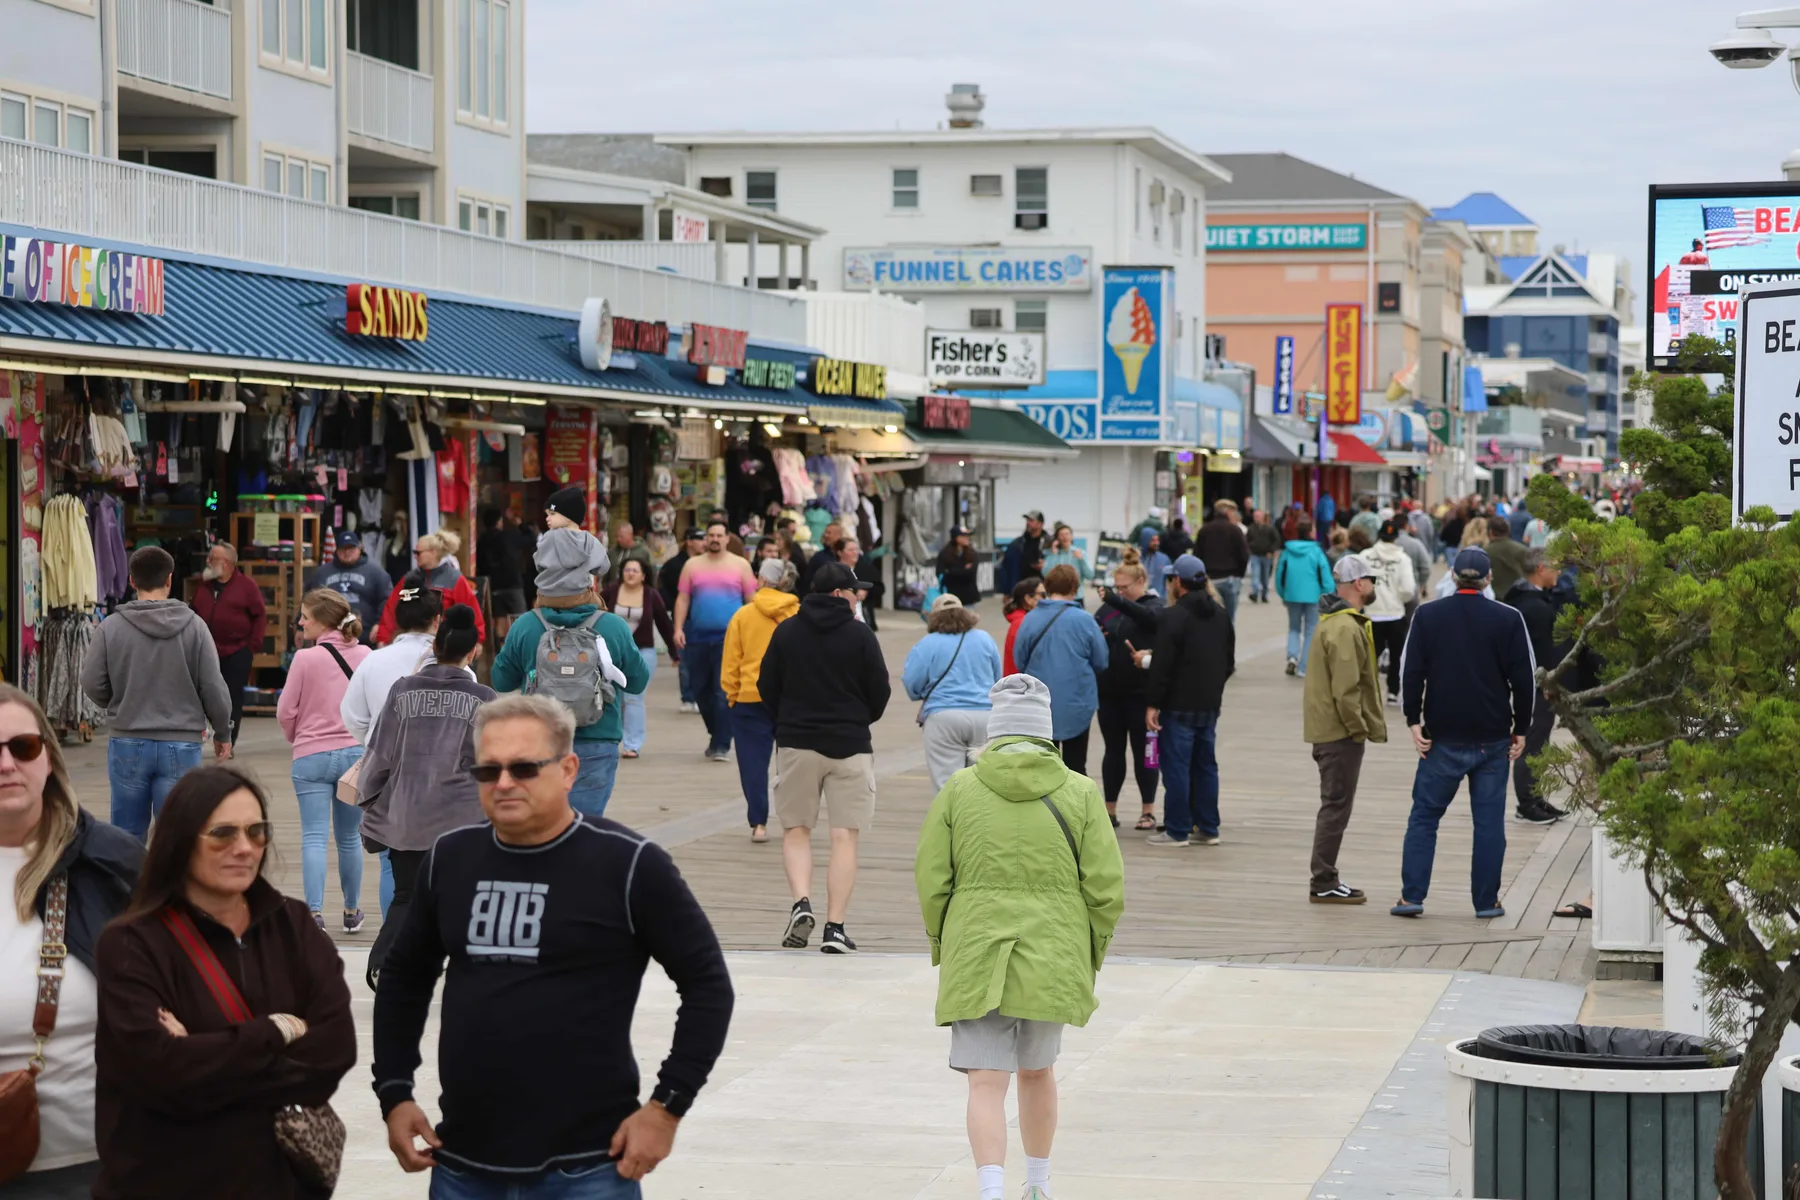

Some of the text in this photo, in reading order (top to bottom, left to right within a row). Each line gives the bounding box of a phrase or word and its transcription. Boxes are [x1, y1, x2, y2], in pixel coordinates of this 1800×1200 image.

[1204, 227, 1330, 246] UIET STORM
[0, 234, 164, 316] E OF ICE CREAM
[874, 260, 1064, 282] FUNNEL CAKES
[1720, 274, 1745, 291] ON
[360, 283, 427, 343] SANDS
[931, 336, 1007, 363] Fisher's
[1765, 320, 1800, 353] BE
[743, 359, 796, 390] FRUIT FIESTA
[815, 357, 853, 395] OCEAN
[936, 364, 1001, 377] POP CORN
[1334, 360, 1352, 421] CITY
